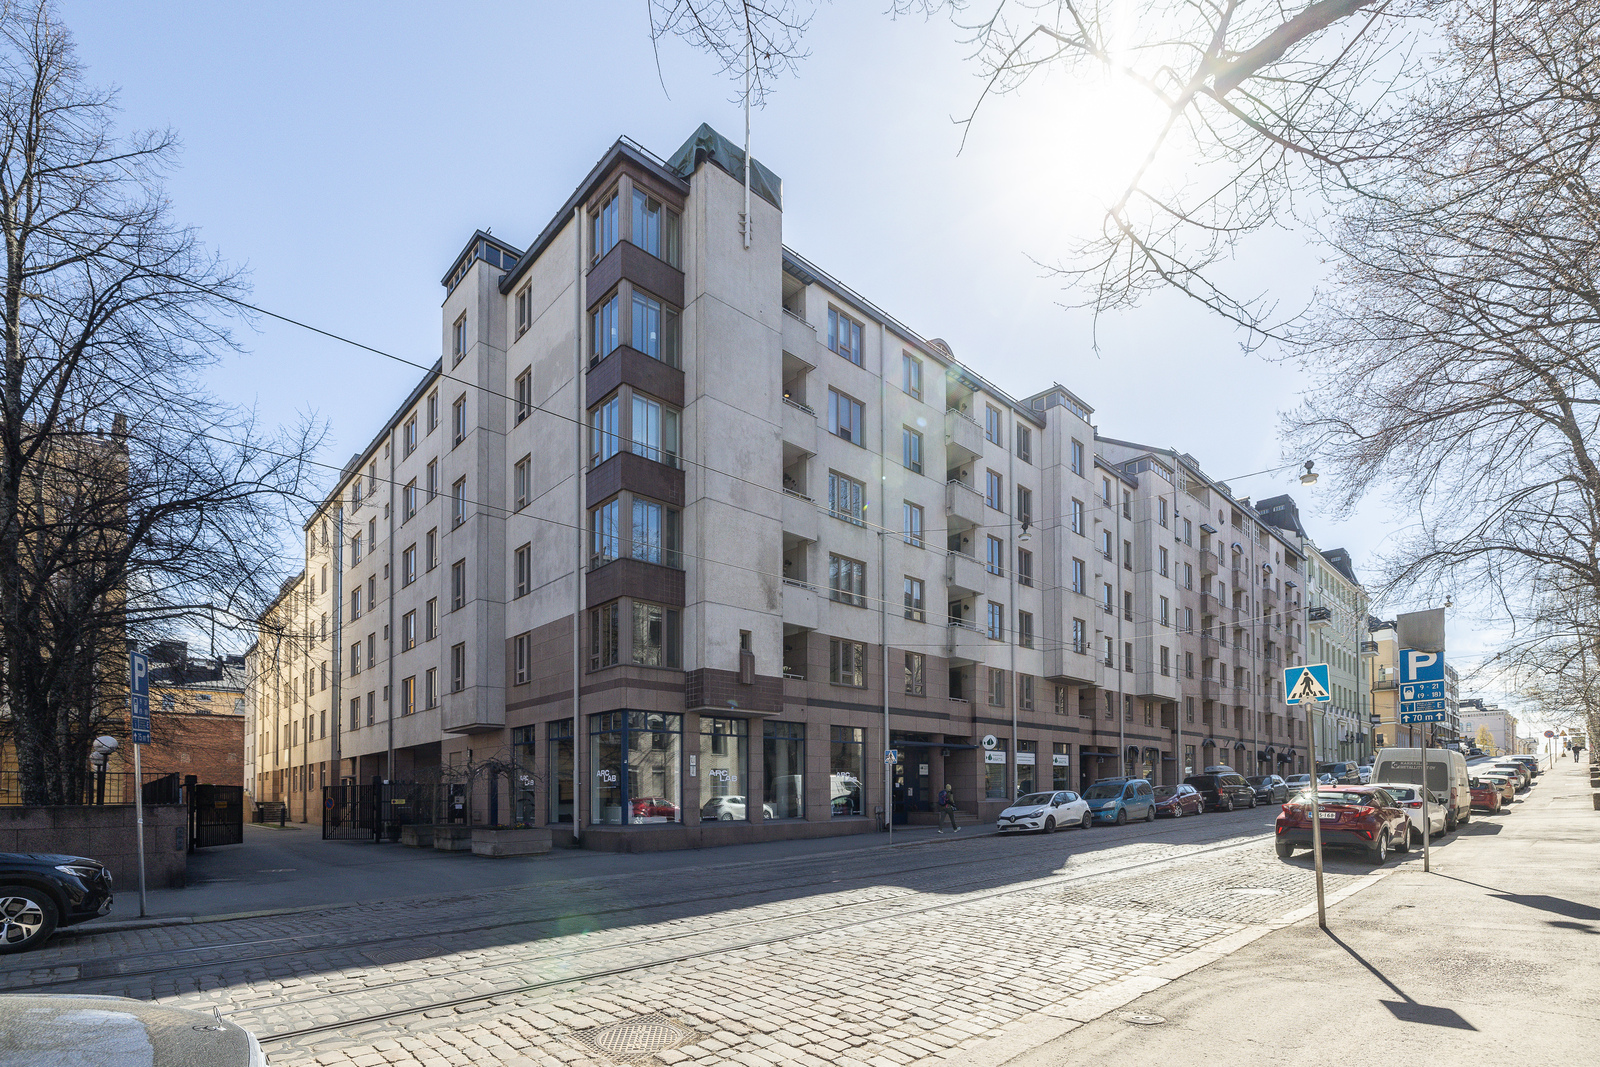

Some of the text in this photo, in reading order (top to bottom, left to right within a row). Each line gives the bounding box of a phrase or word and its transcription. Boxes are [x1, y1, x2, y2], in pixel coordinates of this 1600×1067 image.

[1408, 651, 1437, 680] P
[134, 656, 146, 691] P
[1412, 714, 1423, 722] 70
[596, 769, 610, 777] ARC
[709, 769, 728, 777] ARC
